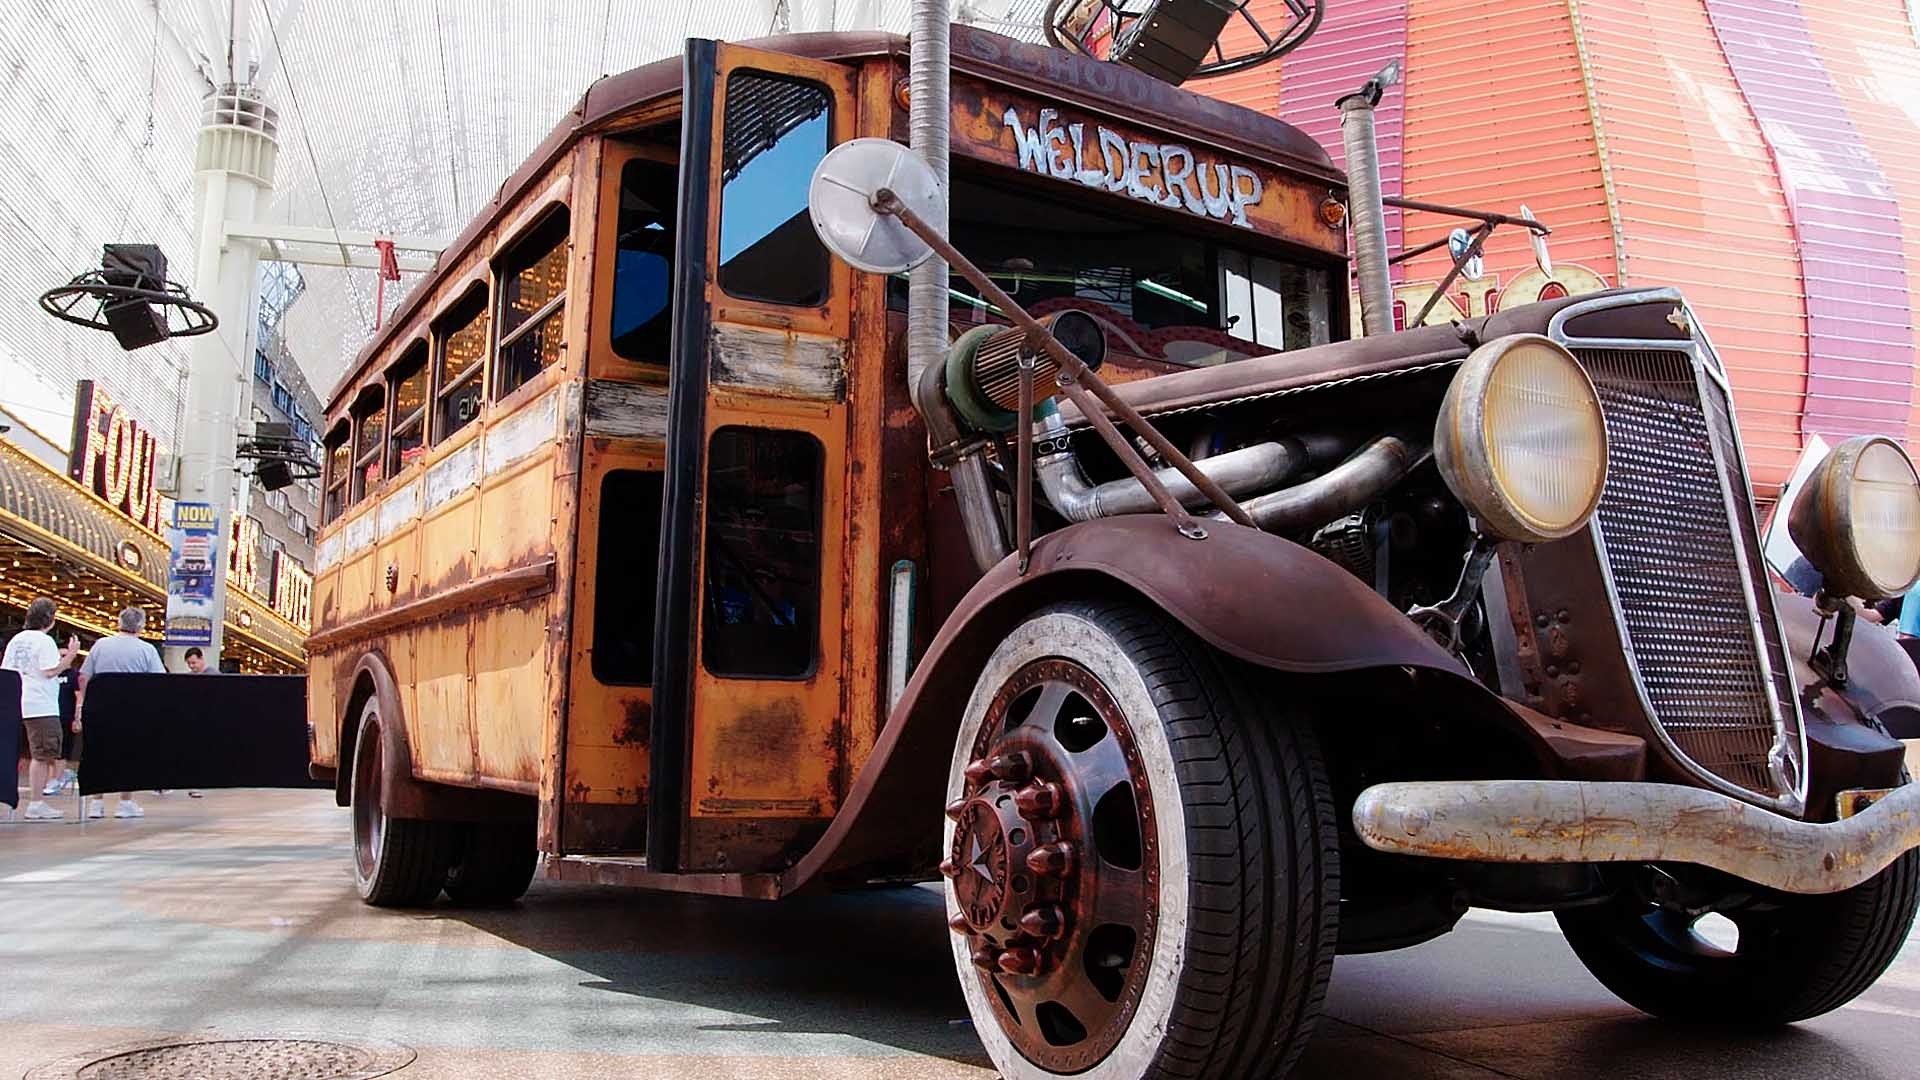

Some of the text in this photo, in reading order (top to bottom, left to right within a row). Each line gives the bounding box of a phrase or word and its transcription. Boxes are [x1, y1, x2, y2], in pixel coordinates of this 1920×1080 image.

[967, 30, 1166, 104] SCHOO
[1002, 105, 1262, 229] WELDERUP
[177, 505, 215, 521] NOW
